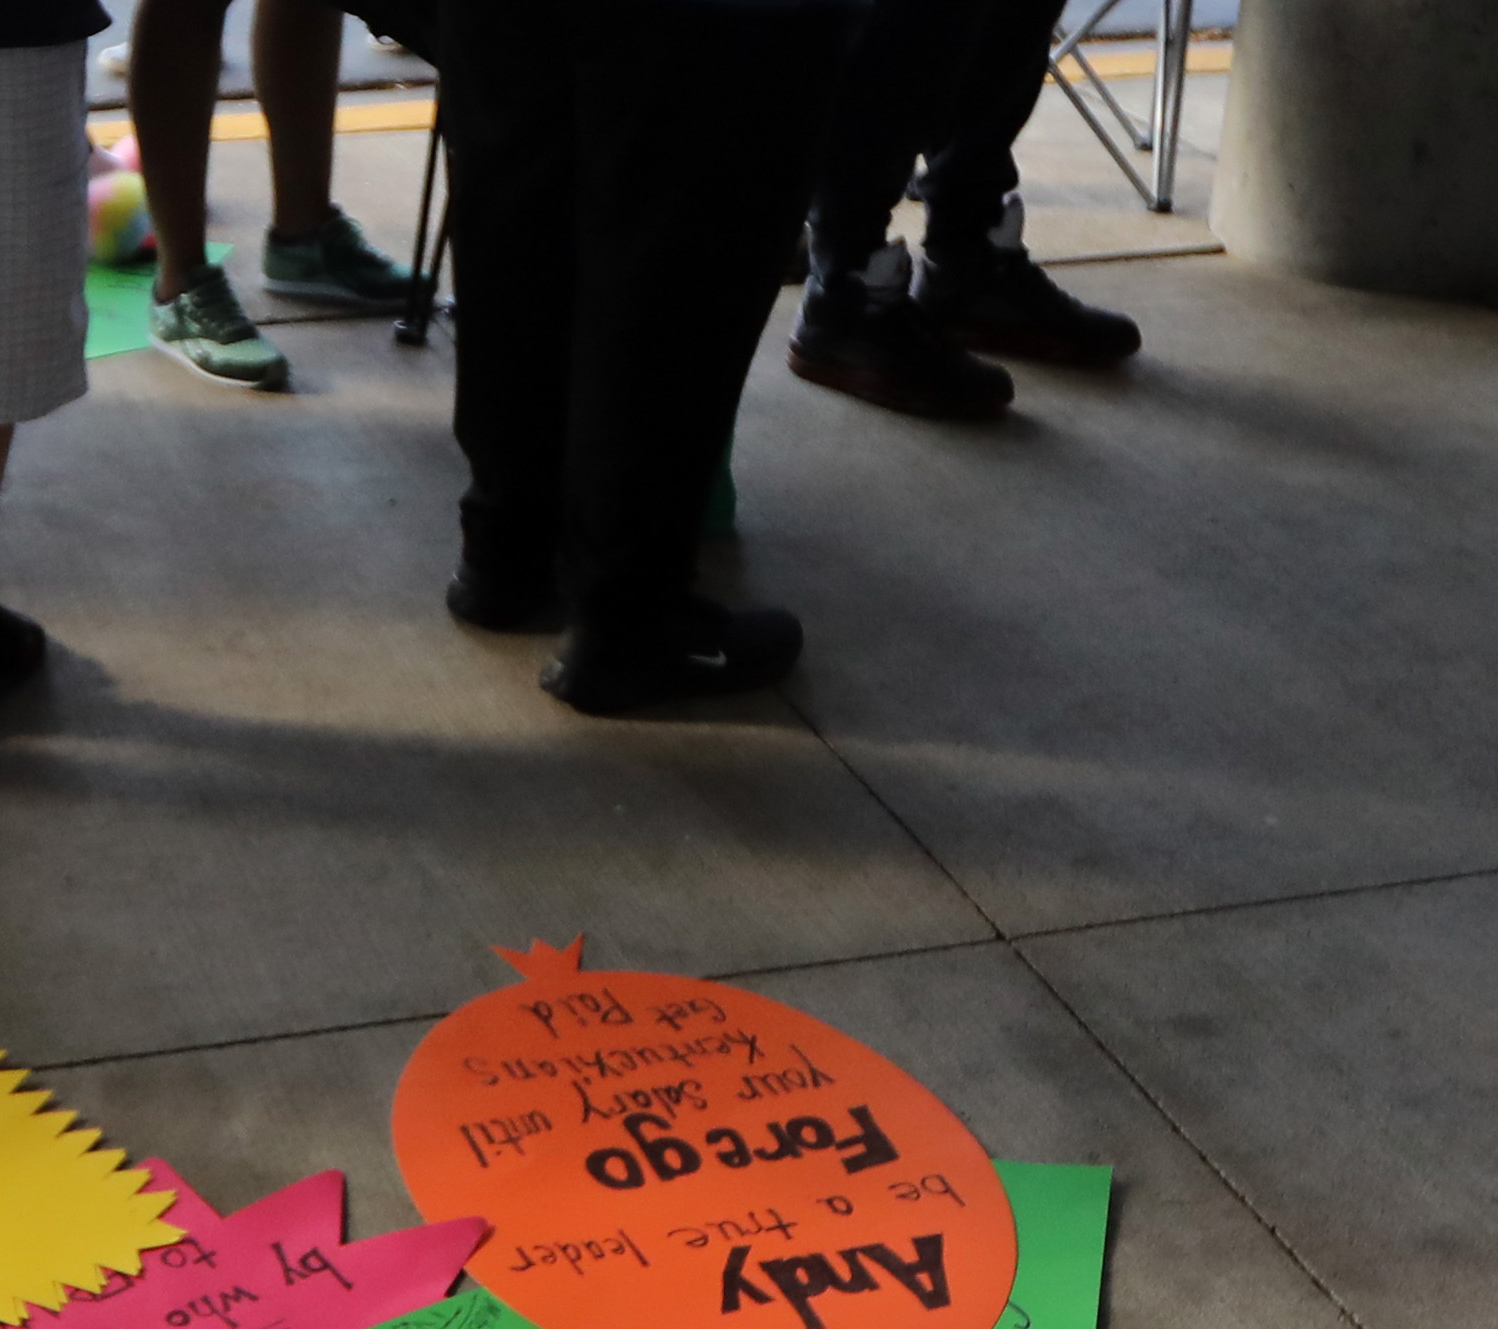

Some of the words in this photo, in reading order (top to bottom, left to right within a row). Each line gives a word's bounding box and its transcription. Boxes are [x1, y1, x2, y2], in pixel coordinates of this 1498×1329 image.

[517, 987, 632, 1037] Paid
[644, 996, 726, 1029] Get
[735, 1044, 833, 1101] your
[458, 1109, 551, 1167] until
[815, 1194, 852, 1218] a
[887, 1172, 964, 1207] be
[506, 1228, 648, 1275] leader
[666, 1208, 796, 1249] true
[158, 1236, 215, 1270] to
[267, 1241, 352, 1290] by
[720, 1232, 950, 1329] Andy
[163, 1284, 258, 1329] who
